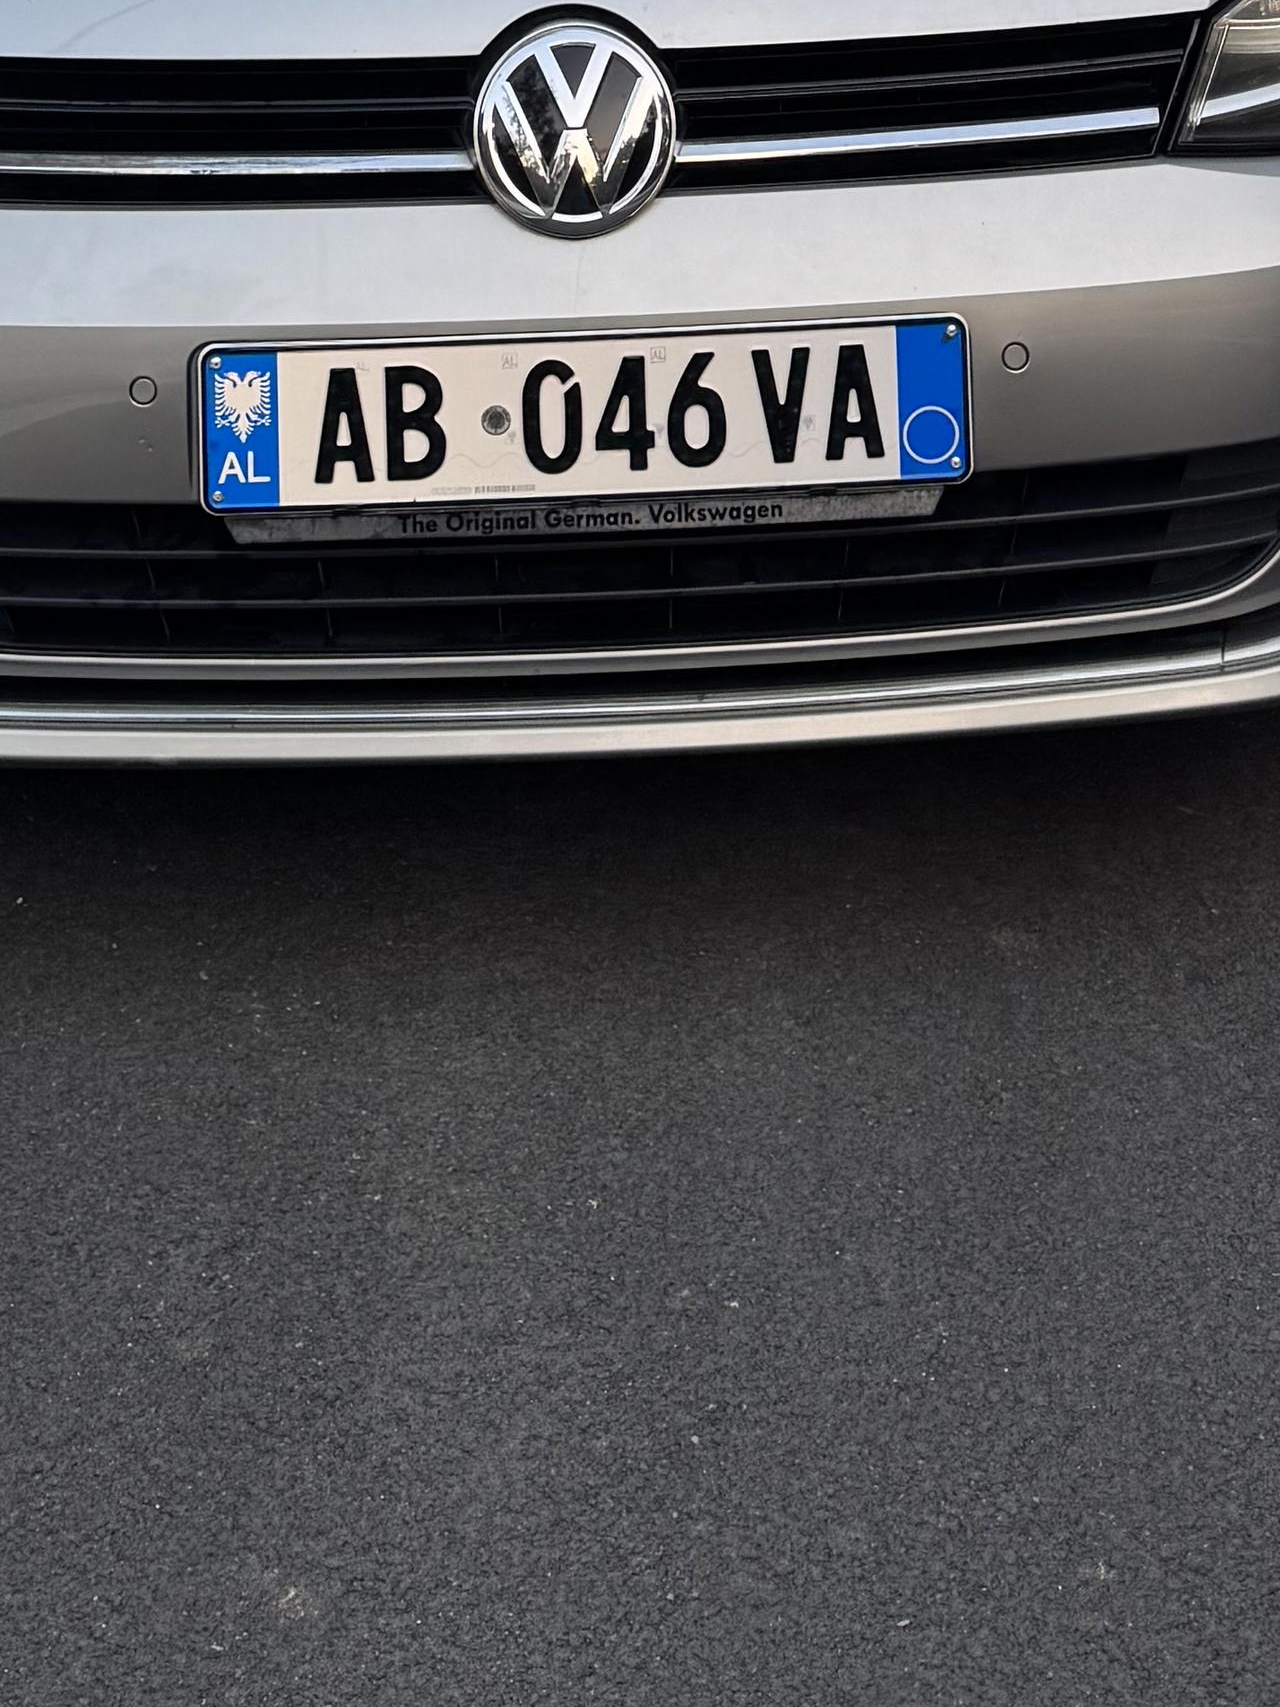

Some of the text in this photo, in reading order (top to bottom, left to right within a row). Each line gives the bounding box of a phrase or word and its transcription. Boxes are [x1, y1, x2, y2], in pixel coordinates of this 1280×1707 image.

[484, 37, 662, 221] VW
[315, 344, 885, 483] AB 046 VA
[218, 451, 271, 484] AL
[399, 501, 783, 535] The Original German. Volkswagen
